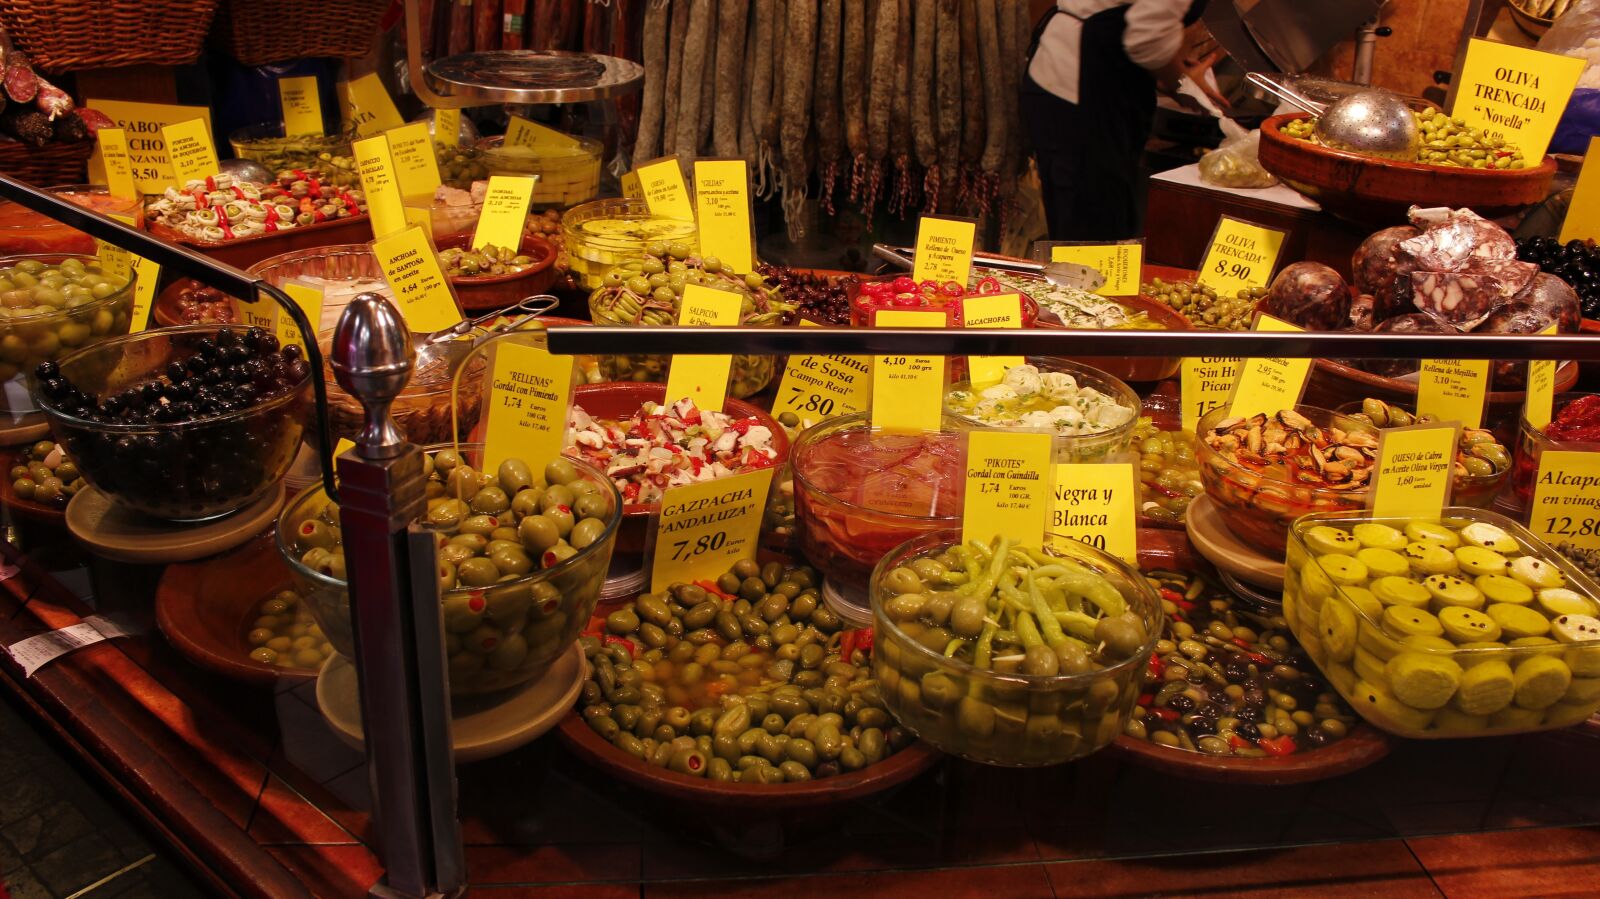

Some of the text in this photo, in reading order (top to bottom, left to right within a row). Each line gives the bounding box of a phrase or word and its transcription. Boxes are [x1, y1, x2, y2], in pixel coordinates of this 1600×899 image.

[1495, 66, 1540, 89] OLIVA
[1474, 83, 1546, 114] TRENCADA
[118, 120, 167, 134] SABO
[132, 167, 159, 181] 8,50
[706, 198, 719, 206] 3,10
[929, 235, 957, 245] PIMIENTO
[1225, 233, 1256, 250] OLIVA
[389, 249, 418, 265] ANCHOAS
[396, 257, 425, 273] SANTOÑA
[924, 262, 938, 270] 2,78
[1214, 259, 1251, 280] 8,90
[402, 270, 420, 279] aceite
[402, 283, 418, 294] 4,64
[689, 306, 719, 319] SALPICÓN
[689, 317, 696, 325] de
[967, 316, 1010, 326] ALCACHOFAS
[801, 356, 855, 383] de Sosa
[1193, 367, 1218, 378] "Sin
[1257, 364, 1272, 375] 2,95
[1424, 364, 1445, 373] Rellena
[1454, 368, 1478, 378] Mejillón
[509, 371, 553, 389] "RELLENAS"
[786, 366, 854, 395] "Campo Real"
[1433, 376, 1450, 384] 3,10
[493, 379, 559, 402] Gordal con Pimiento
[504, 396, 522, 409] 1,74
[787, 387, 835, 416] 7,80
[519, 420, 530, 429] kilo
[984, 458, 1026, 470] "PIKOTES"
[1392, 451, 1442, 464] QUESO de Cabra
[1391, 465, 1410, 473] Aceite
[1411, 463, 1428, 472] Oliva
[1430, 462, 1448, 472] Virgen
[967, 468, 1040, 483] Gordal con Guindilla
[1397, 476, 1414, 486] 1,60
[981, 483, 1027, 496] 1,74 Euros
[663, 488, 753, 518] GAZPACHA
[1103, 489, 1113, 505] y
[1542, 495, 1559, 505] en
[658, 503, 755, 535] "ANDALUZA"
[1053, 509, 1108, 527] Blanca
[671, 531, 746, 562] 7,80 Euros
[726, 548, 741, 560] kilo
